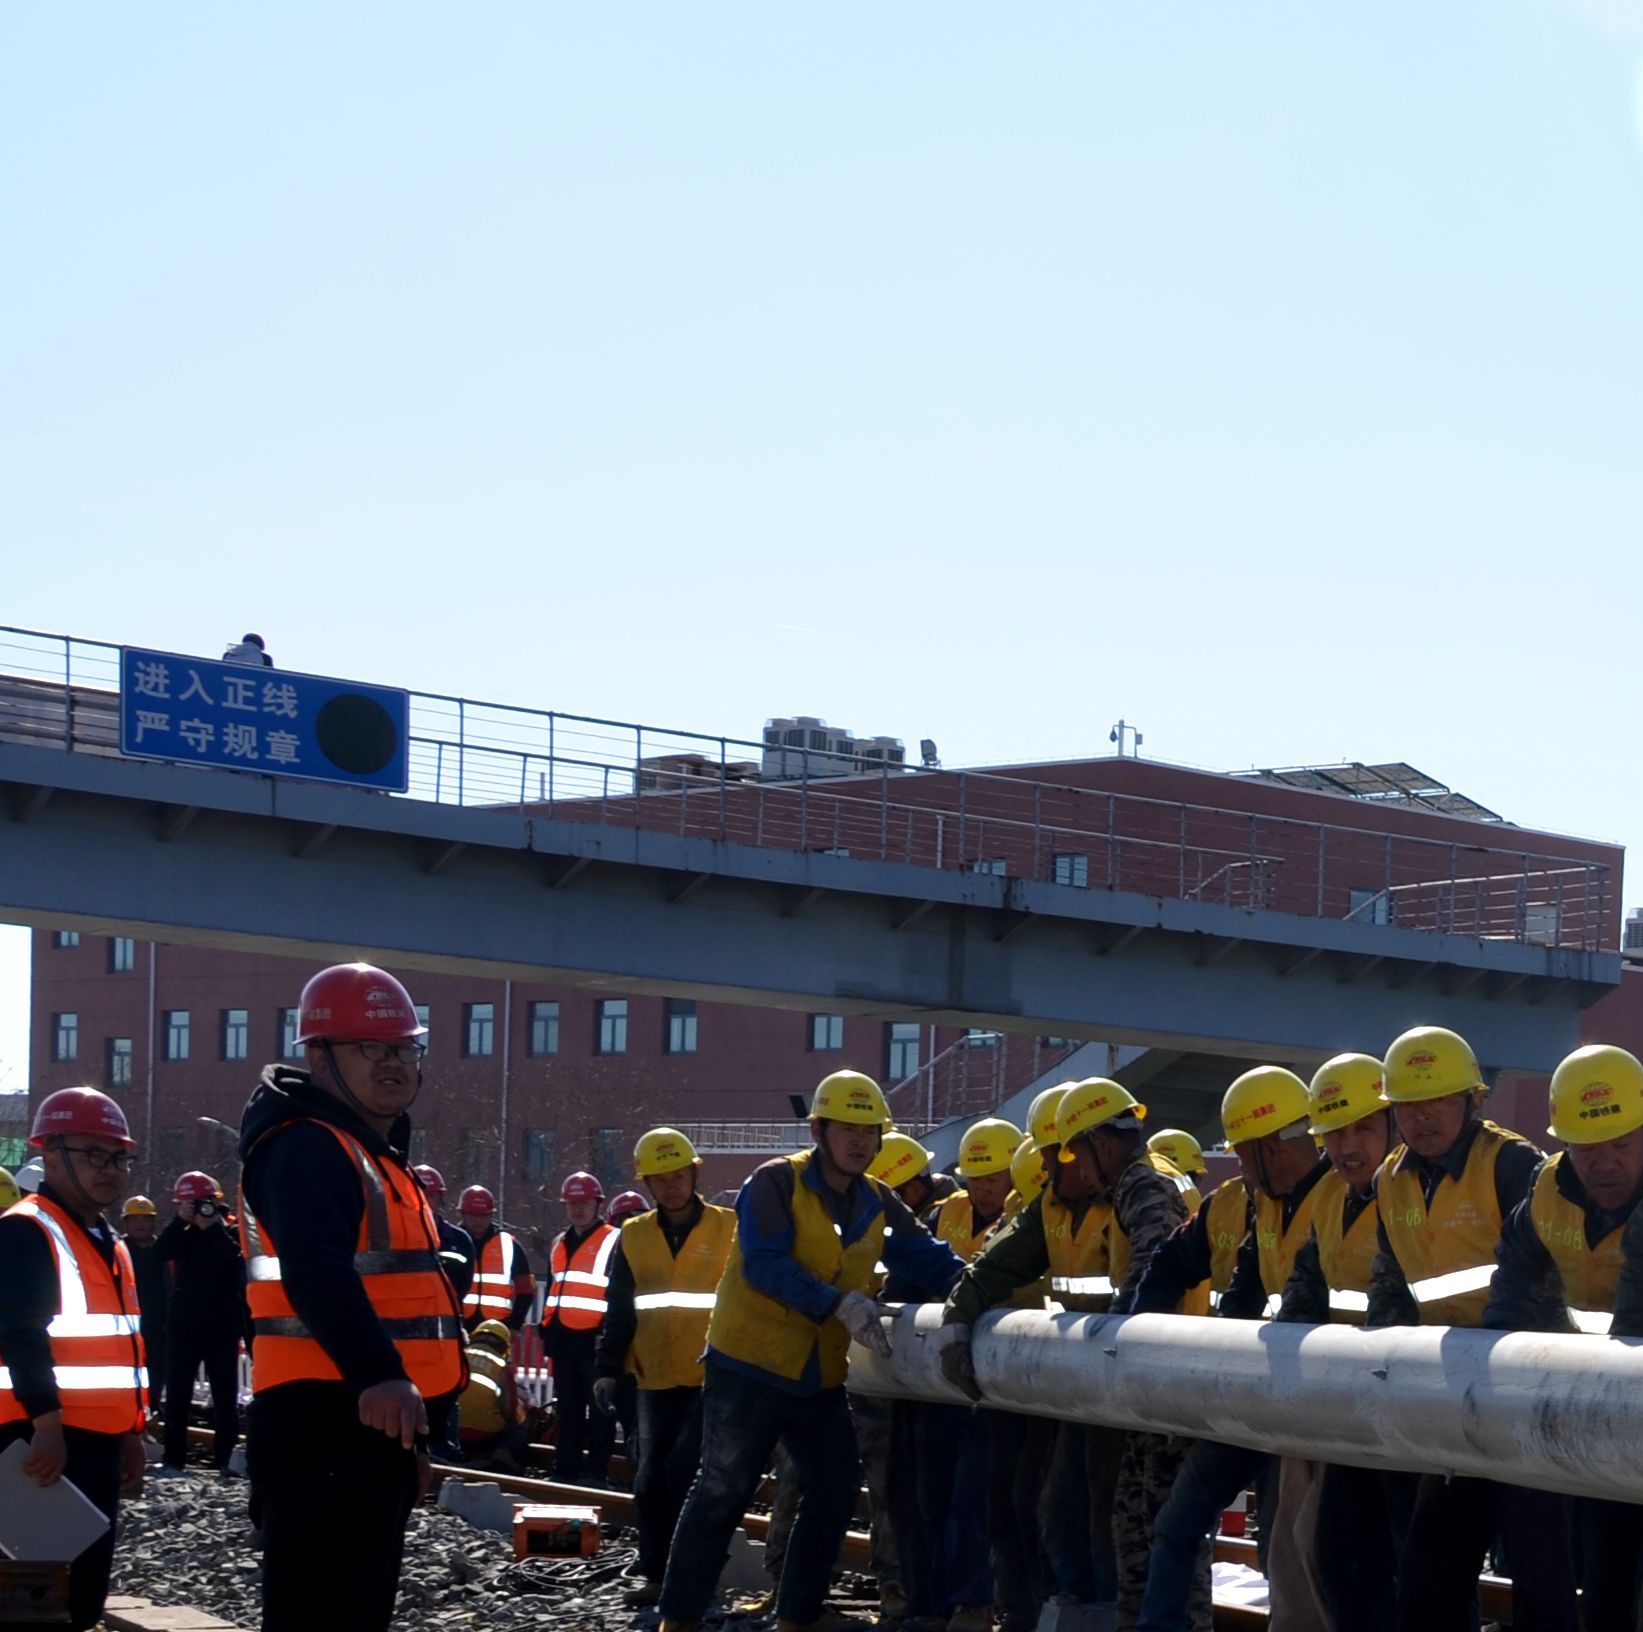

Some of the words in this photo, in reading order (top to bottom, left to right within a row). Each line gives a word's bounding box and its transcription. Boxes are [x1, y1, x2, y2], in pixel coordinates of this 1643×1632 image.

[134, 662, 298, 719] 进入正线
[135, 710, 300, 764] 严守规章
[1579, 1103, 1621, 1120] 中国铁建
